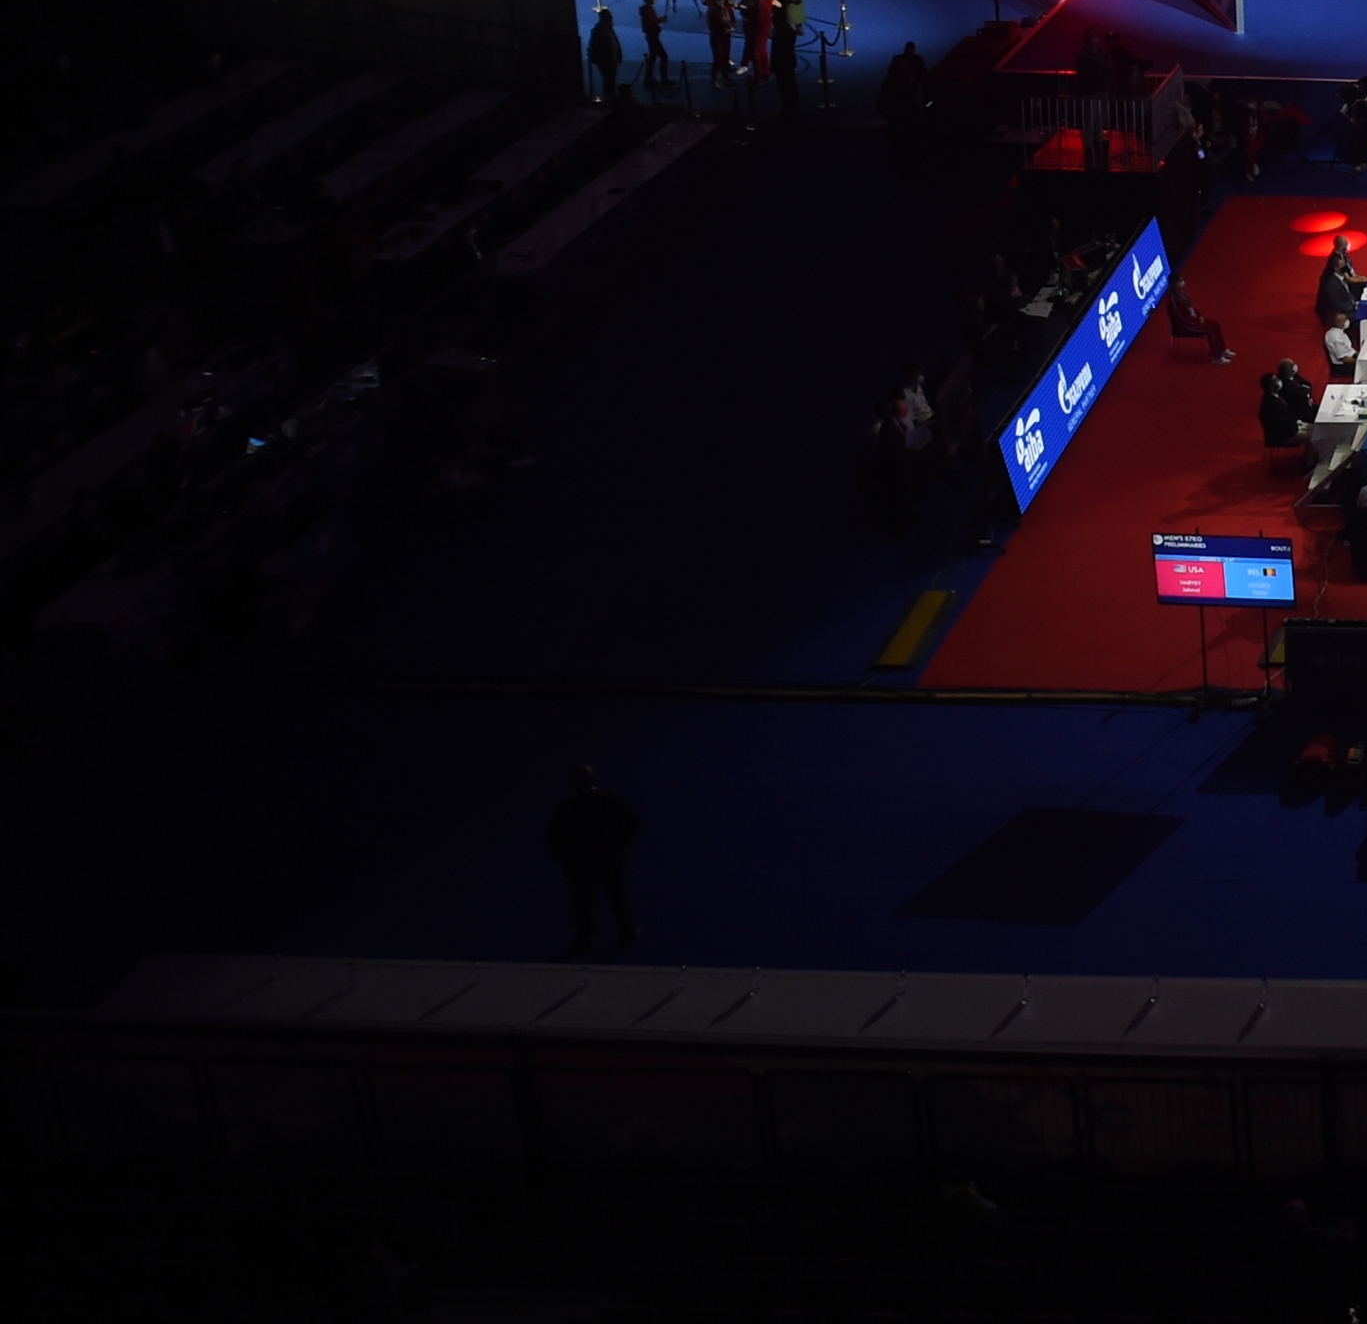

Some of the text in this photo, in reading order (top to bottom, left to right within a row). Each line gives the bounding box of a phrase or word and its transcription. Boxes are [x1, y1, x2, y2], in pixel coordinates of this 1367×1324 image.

[1106, 310, 1123, 348] aiba
[1024, 429, 1045, 473] aiba
[1188, 566, 1204, 574] USA
